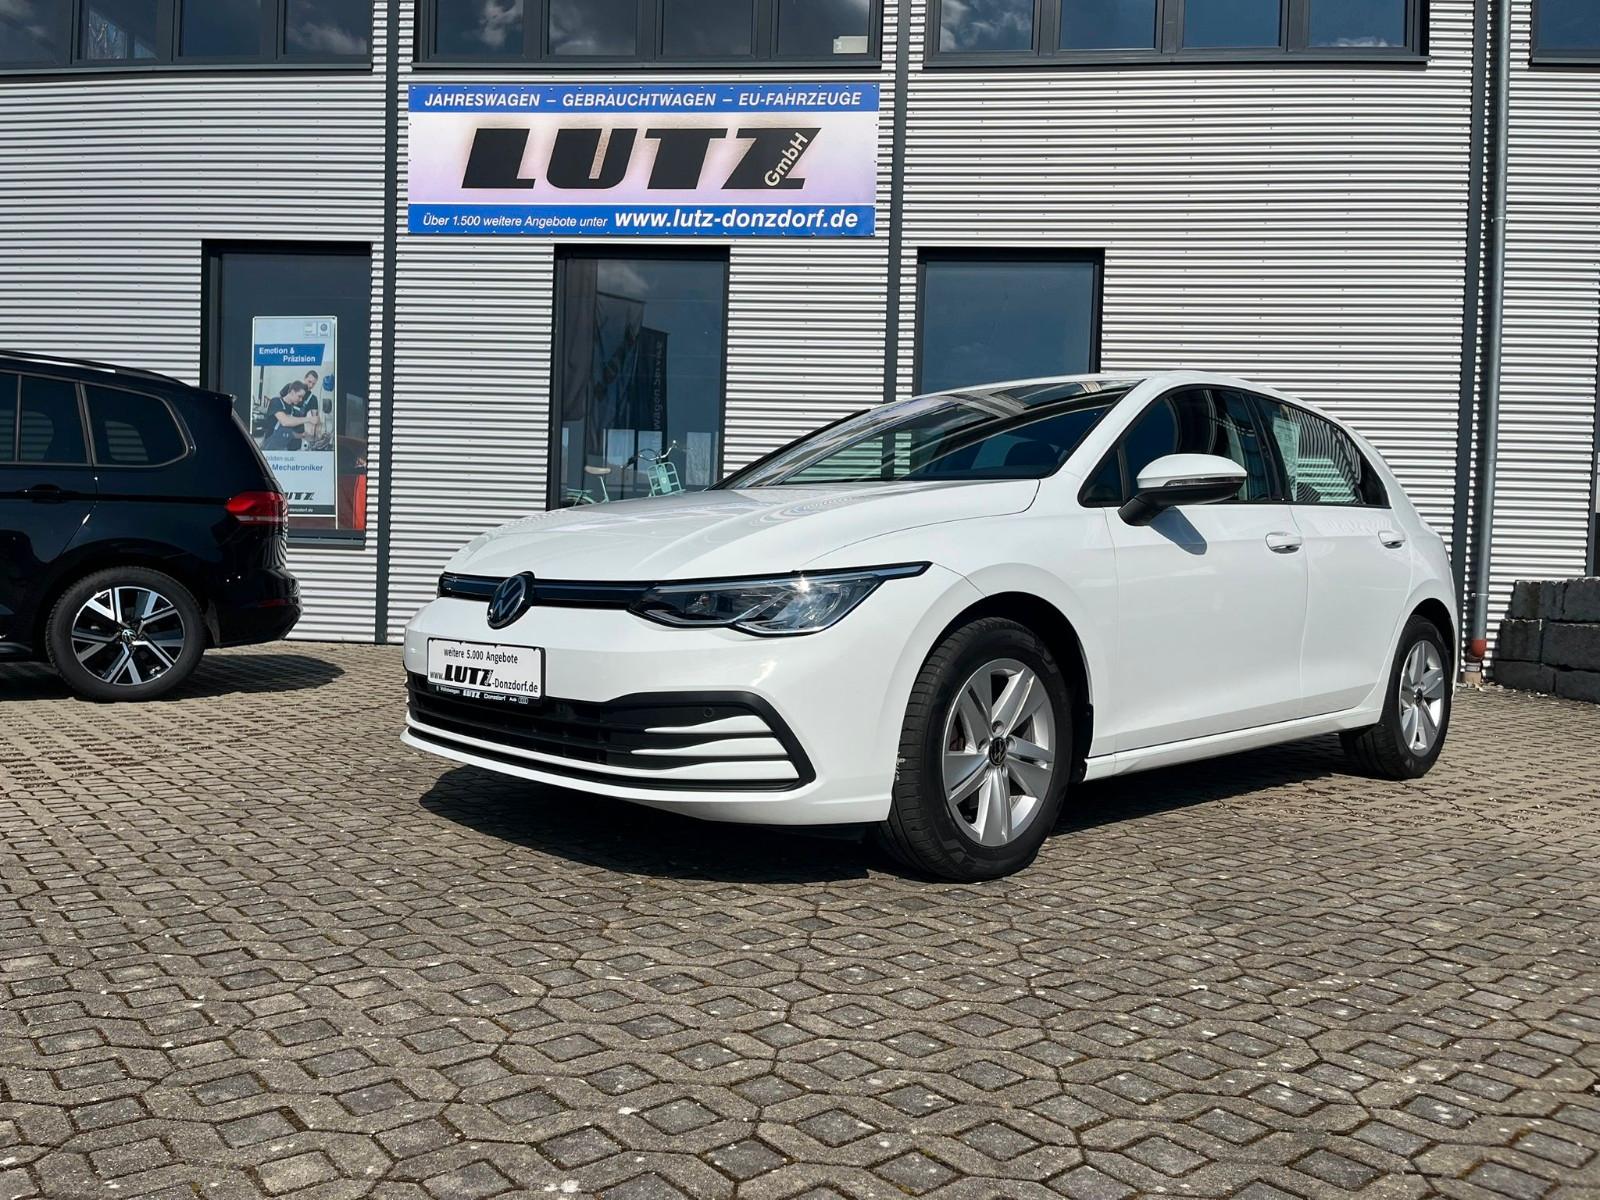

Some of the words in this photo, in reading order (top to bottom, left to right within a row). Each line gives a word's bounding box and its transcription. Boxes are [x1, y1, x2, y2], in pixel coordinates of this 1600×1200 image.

[424, 93, 540, 107] JAHRESWAGEN
[562, 93, 716, 107] GEBRAUCHTWAGEN
[738, 92, 862, 106] EU-FAHRZEUGE
[461, 128, 821, 189] LUTZ
[763, 131, 808, 187] GmbH
[423, 212, 450, 226] Über
[452, 215, 480, 226] 1.500
[483, 215, 522, 227] weitere
[524, 215, 577, 230] Angebote
[579, 217, 608, 227] unter
[614, 208, 858, 228] www.lutz-donzdorf.de
[289, 346, 295, 354] &
[282, 355, 316, 363] Präzision
[653, 388, 663, 430] wagen
[285, 492, 315, 500] UTZ
[444, 647, 465, 659] weitere
[466, 649, 484, 660] 5.000
[486, 651, 518, 664] Angebote
